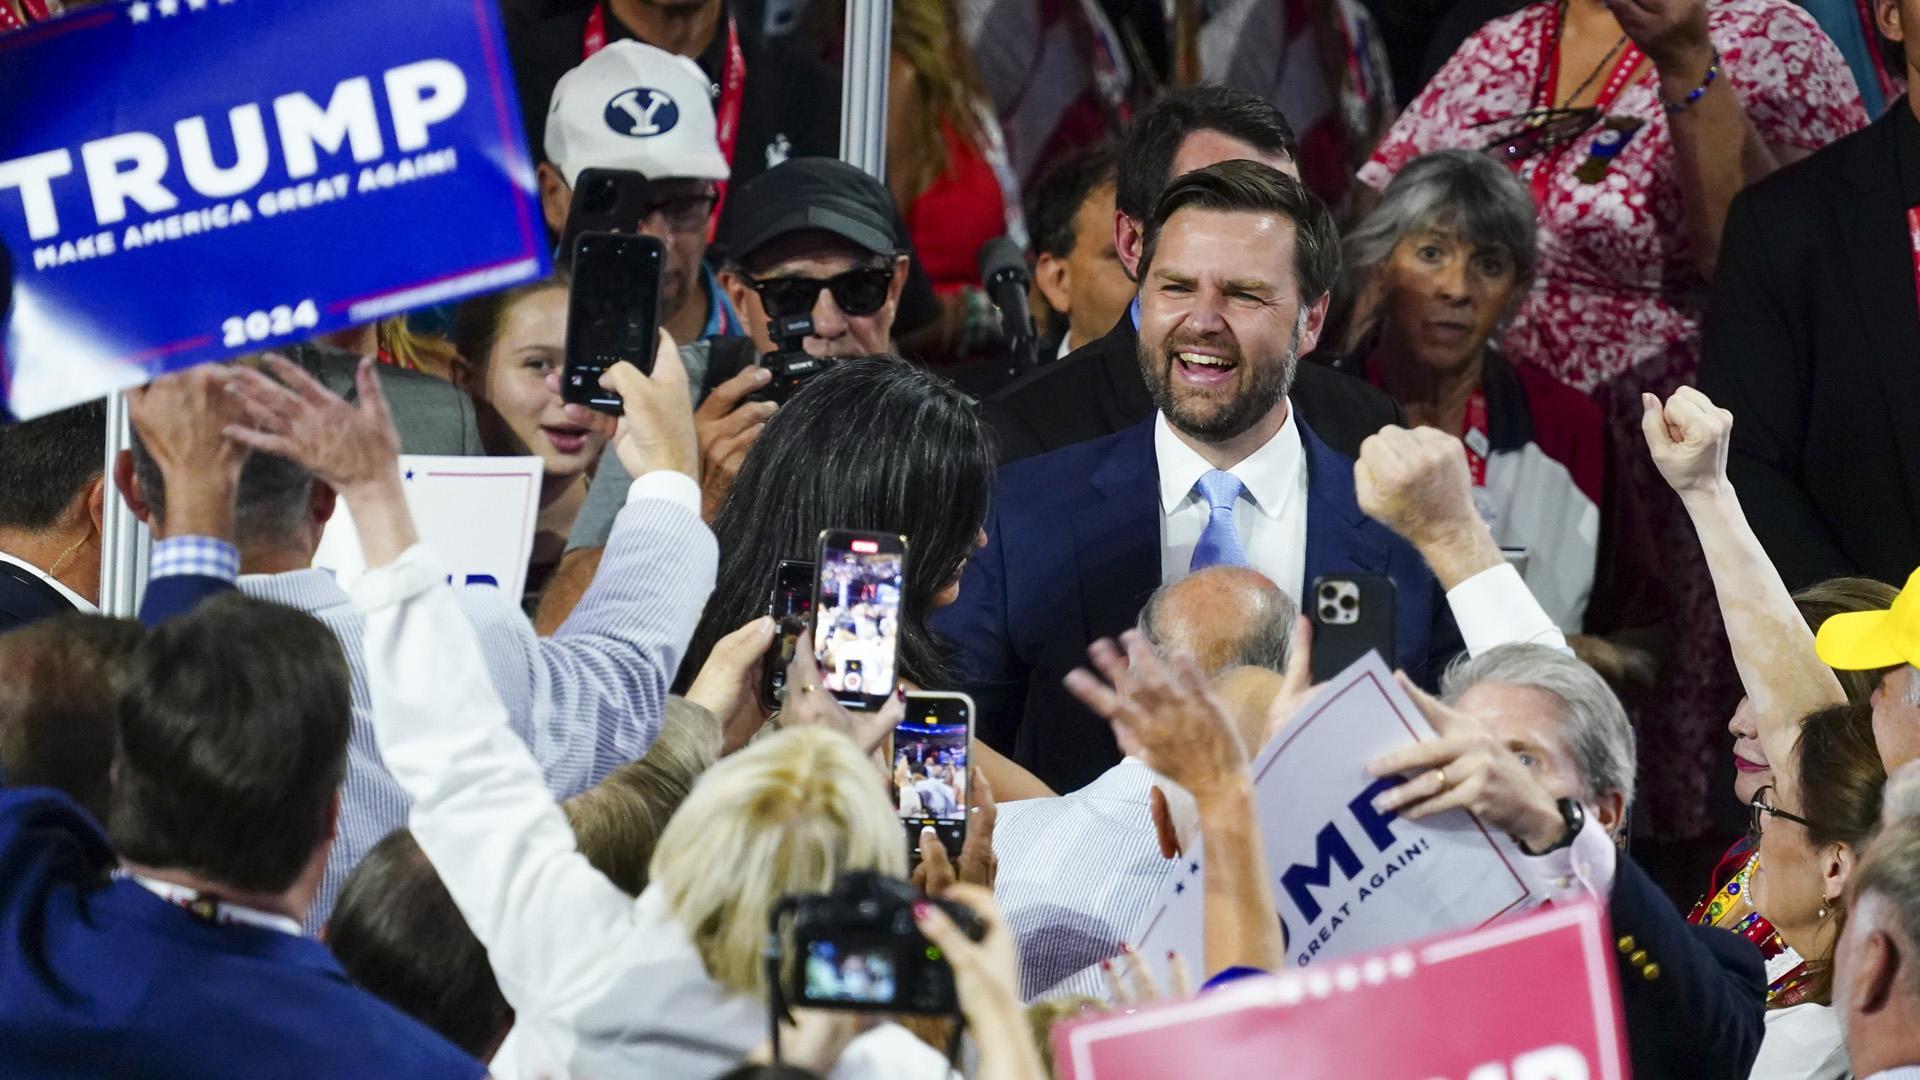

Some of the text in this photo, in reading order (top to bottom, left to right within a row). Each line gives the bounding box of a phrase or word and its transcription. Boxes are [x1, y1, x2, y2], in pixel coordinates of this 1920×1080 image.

[0, 58, 468, 241] TRUMP
[611, 90, 670, 134] Y
[33, 148, 457, 271] MAKE AMERICA GREAT AGAIN!
[222, 299, 319, 348] 2024
[1277, 774, 1408, 954] MP
[1297, 838, 1430, 967] GREAT AGAIN!
